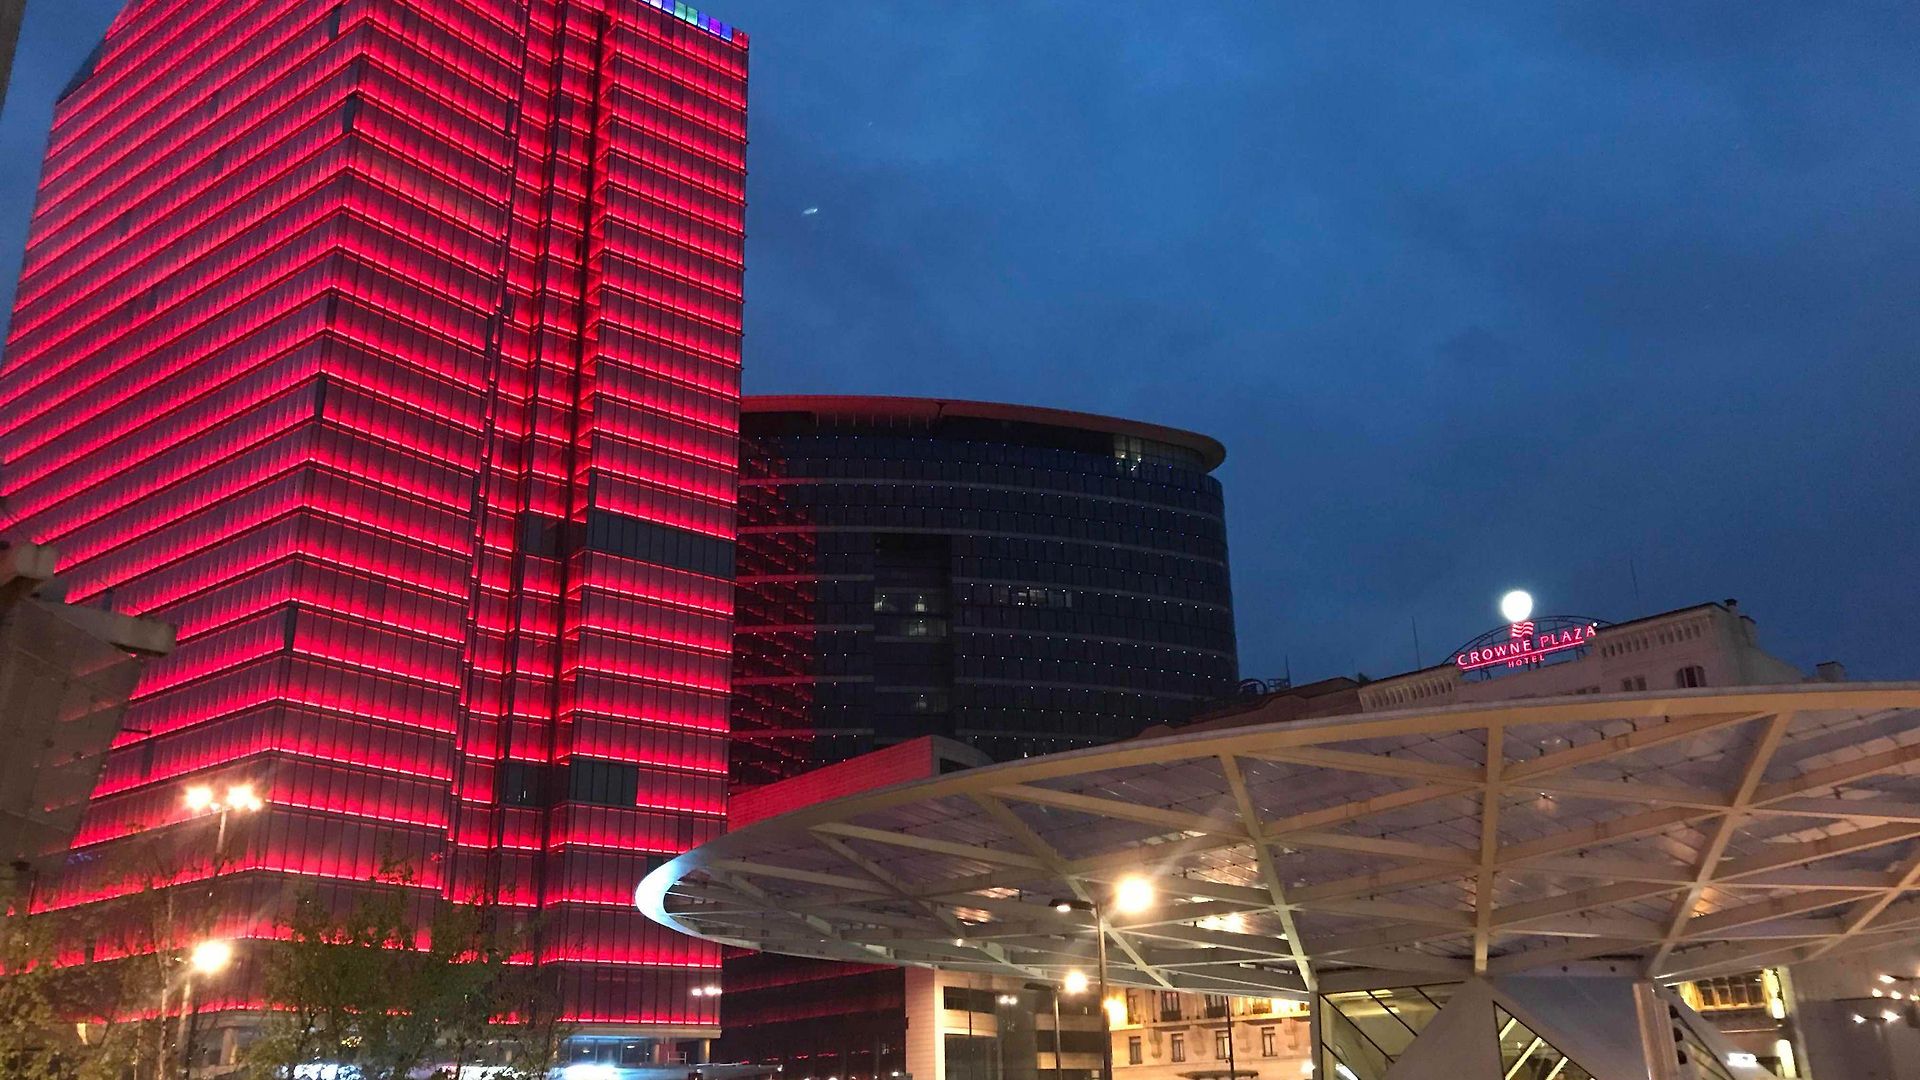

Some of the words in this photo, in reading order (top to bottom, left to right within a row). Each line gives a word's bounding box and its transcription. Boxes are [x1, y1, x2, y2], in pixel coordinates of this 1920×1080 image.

[1457, 639, 1533, 666] CROWNE
[1540, 625, 1596, 648] PLAZA
[1508, 654, 1545, 668] HOTEL
